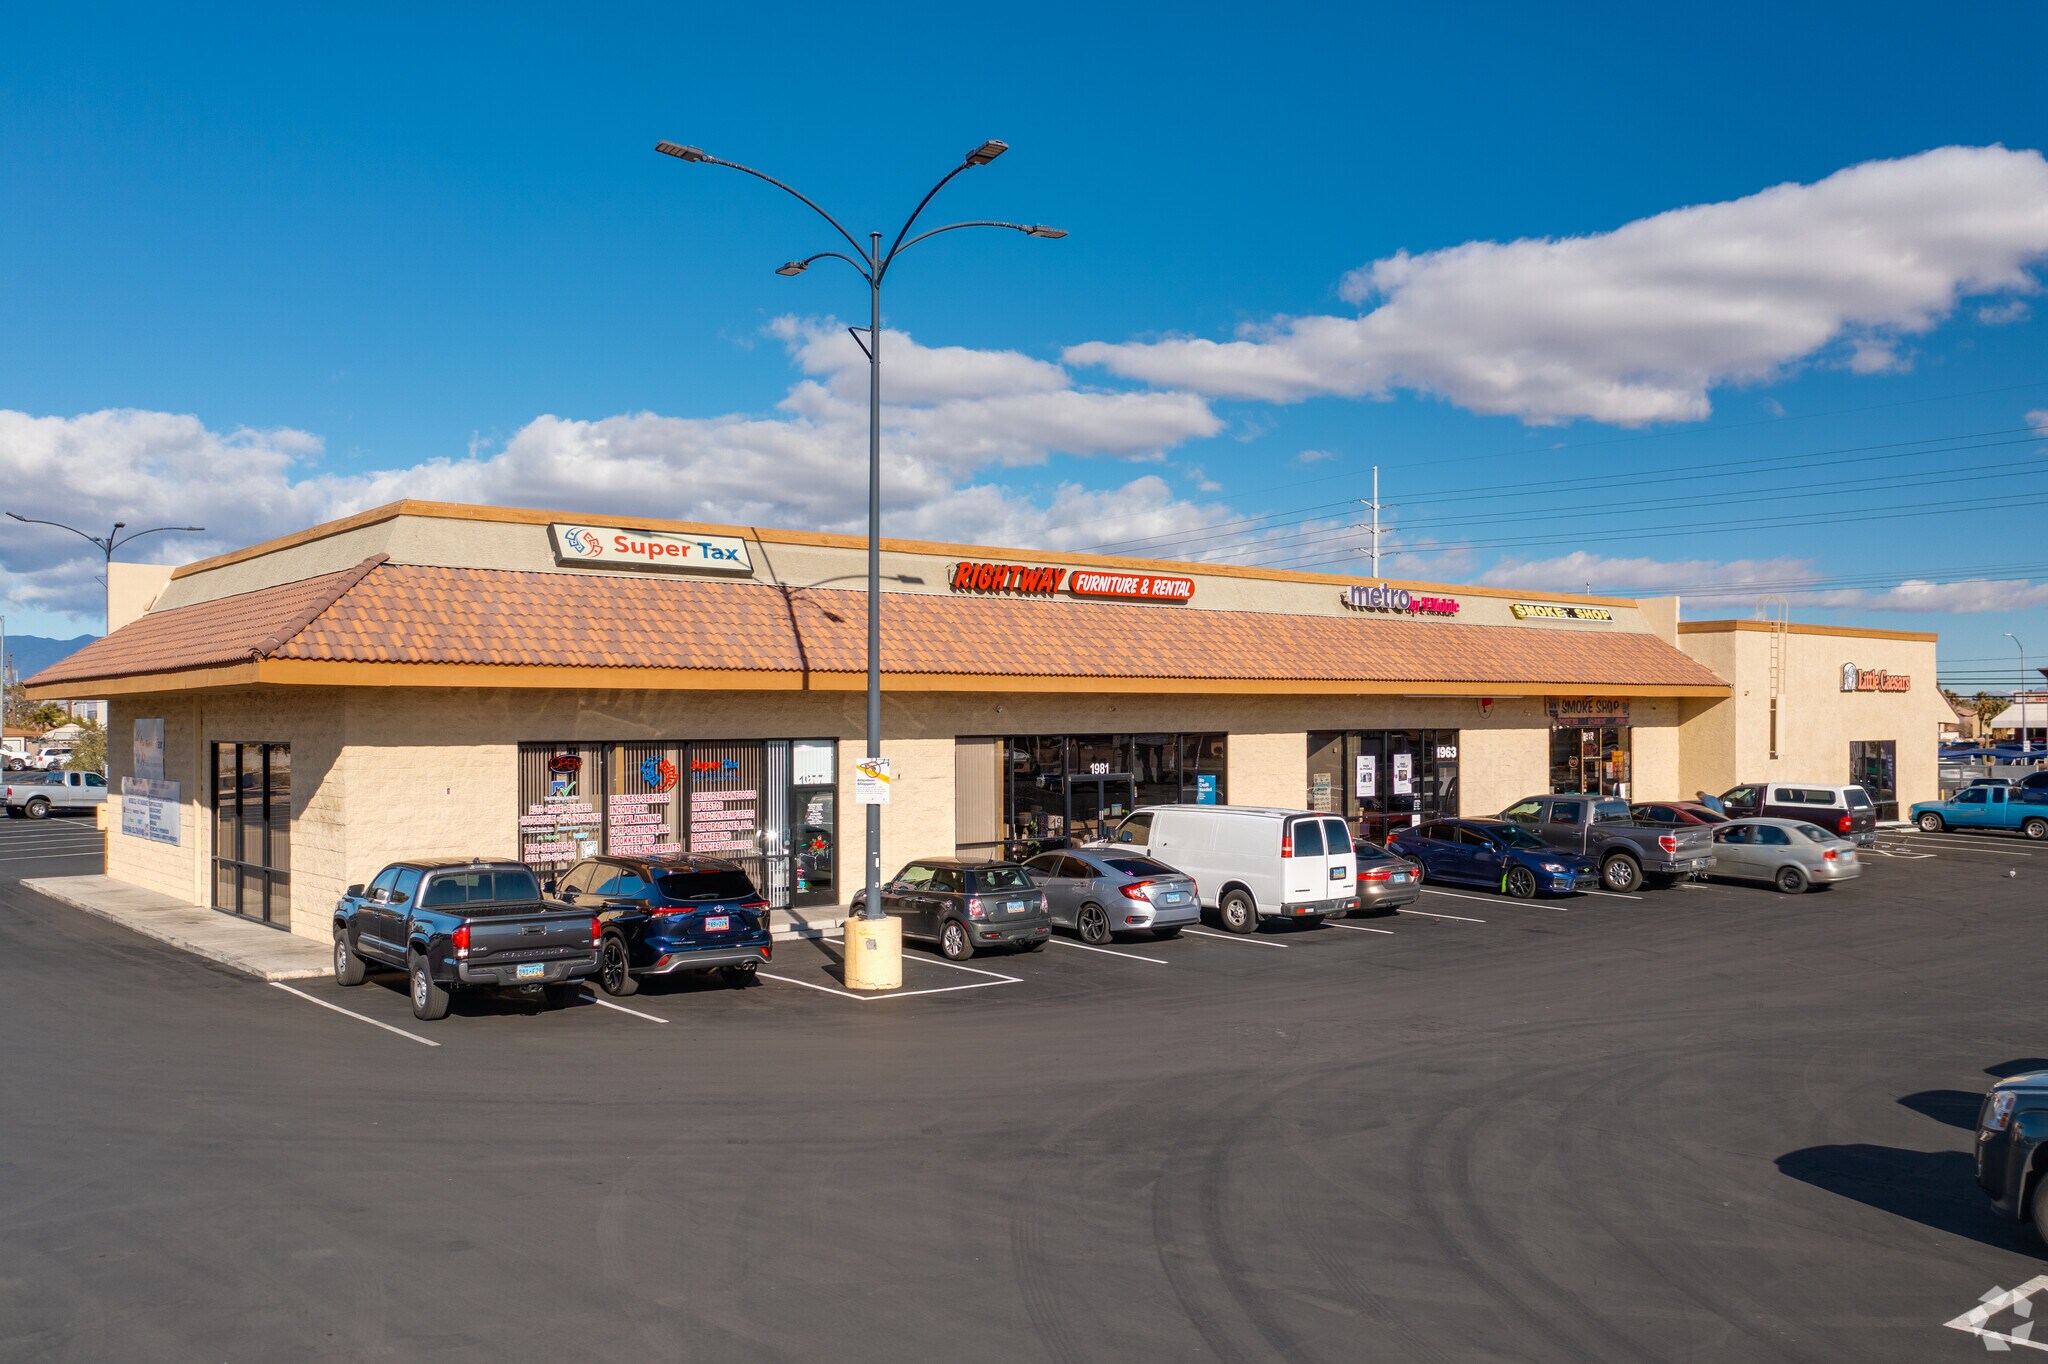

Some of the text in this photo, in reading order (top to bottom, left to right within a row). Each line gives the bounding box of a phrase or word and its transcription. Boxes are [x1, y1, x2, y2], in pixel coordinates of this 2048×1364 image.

[614, 535, 739, 561] Super Tax
[954, 561, 1067, 594] RIGHTWAY
[1076, 574, 1191, 597] FURNITURE & RENTAL
[1350, 583, 1410, 609] metro
[1513, 604, 1610, 620] SMOKE SHOP
[1857, 669, 1910, 691] Little Caesars
[1561, 699, 1619, 714] SMOKE SHOP
[1437, 746, 1457, 758] 1963
[691, 758, 738, 772] Super Tax
[1090, 763, 1109, 774] 1981
[610, 794, 671, 804] BUSINESS SERVICES
[692, 793, 718, 801] SERVICIOS
[547, 804, 564, 814] HOME
[566, 803, 592, 813] BUSINESS
[610, 804, 648, 814] INCOME TAX
[692, 801, 723, 811] IMPUESTOS
[610, 814, 662, 825] TAX PLANNING
[610, 835, 655, 846] BOOKKEEPING
[691, 831, 731, 842] BOOKKEEPING
[610, 843, 681, 856] LICENSES AND PERMITS
[691, 842, 720, 853] LICENCIAS
[525, 854, 540, 863] CELL
